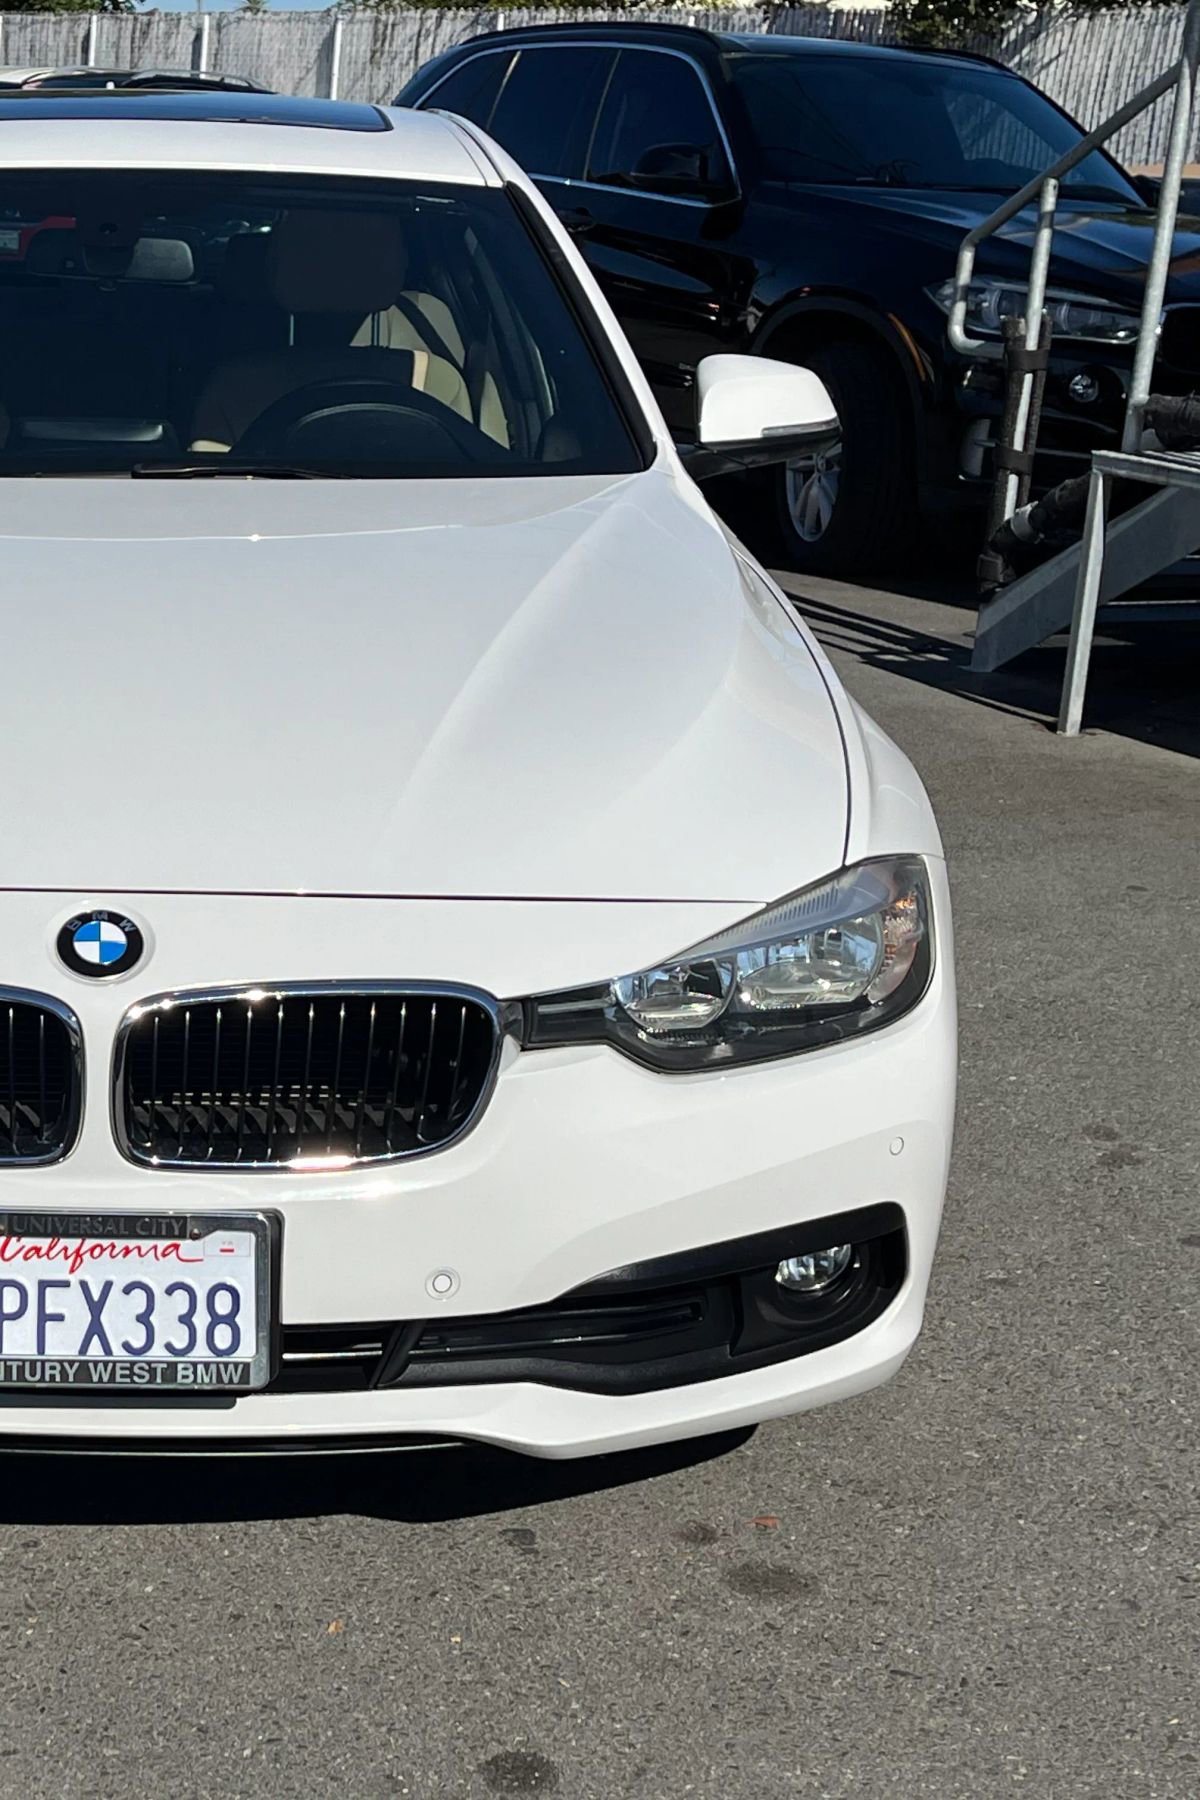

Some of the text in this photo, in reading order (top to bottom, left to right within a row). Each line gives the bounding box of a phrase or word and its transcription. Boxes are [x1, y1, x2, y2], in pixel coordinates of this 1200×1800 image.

[66, 911, 137, 932] BMW
[12, 1215, 185, 1237] UNIVERSAL CITY
[0, 1235, 204, 1274] California
[88, 1362, 168, 1384] WEST
[176, 1364, 244, 1385] BMW
